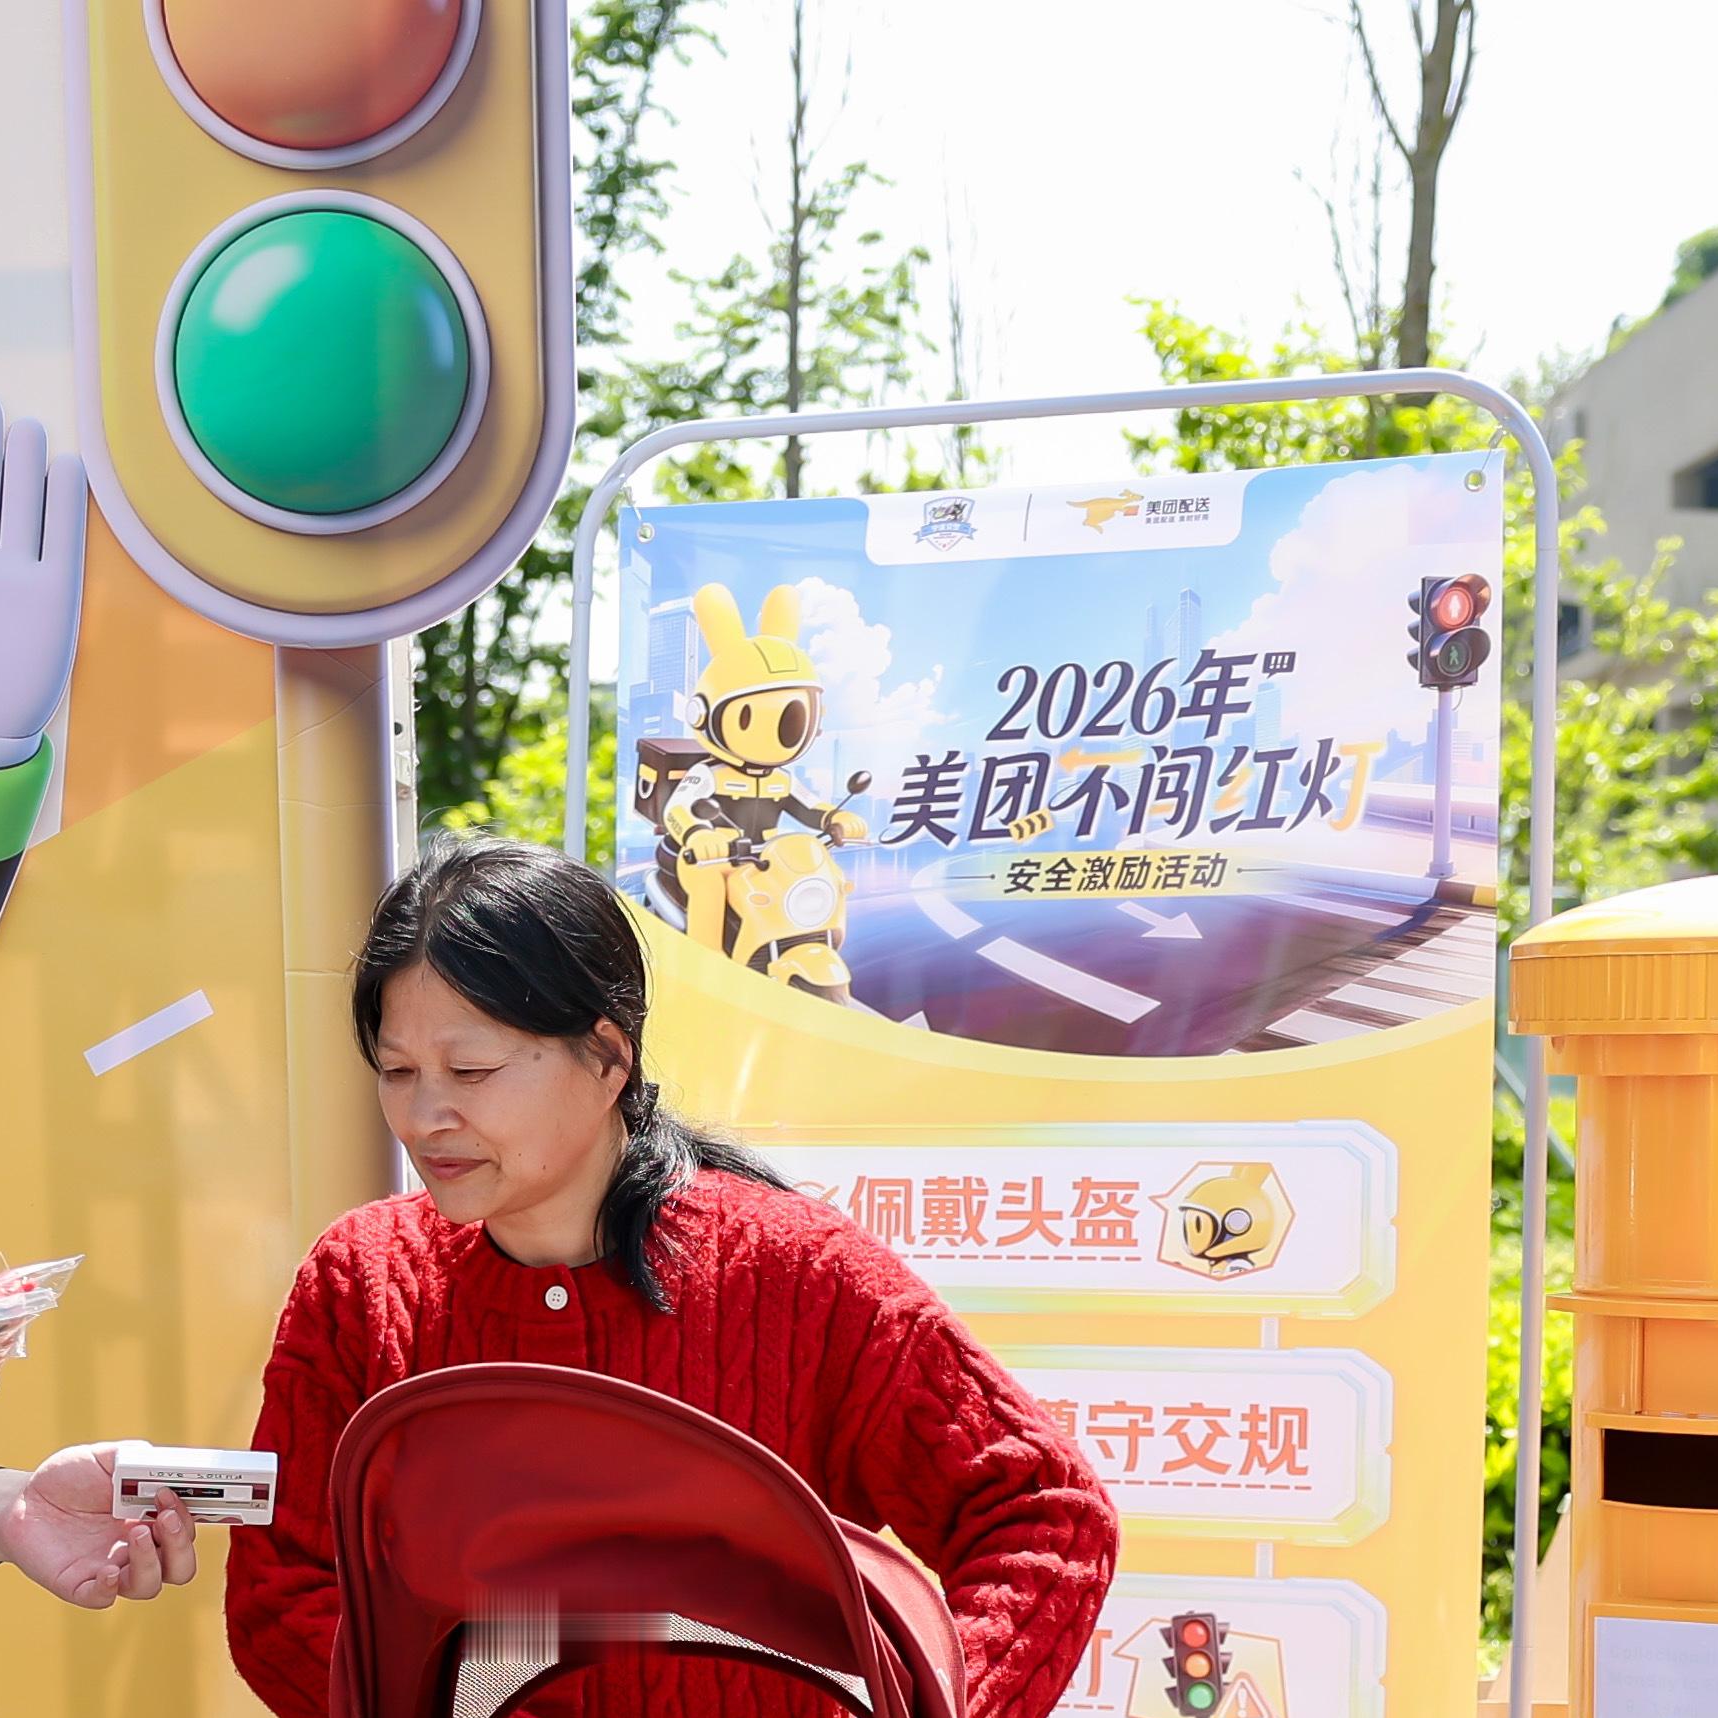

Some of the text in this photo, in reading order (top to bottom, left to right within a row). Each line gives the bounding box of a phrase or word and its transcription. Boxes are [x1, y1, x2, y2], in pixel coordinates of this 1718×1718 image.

[1146, 497, 1210, 516] 美团配送
[984, 649, 1259, 742] 2026年
[879, 737, 1386, 847] 美团不闯红灯
[1003, 852, 1229, 894] 安全激励活动
[847, 1175, 1142, 1249] 佩戴头盔
